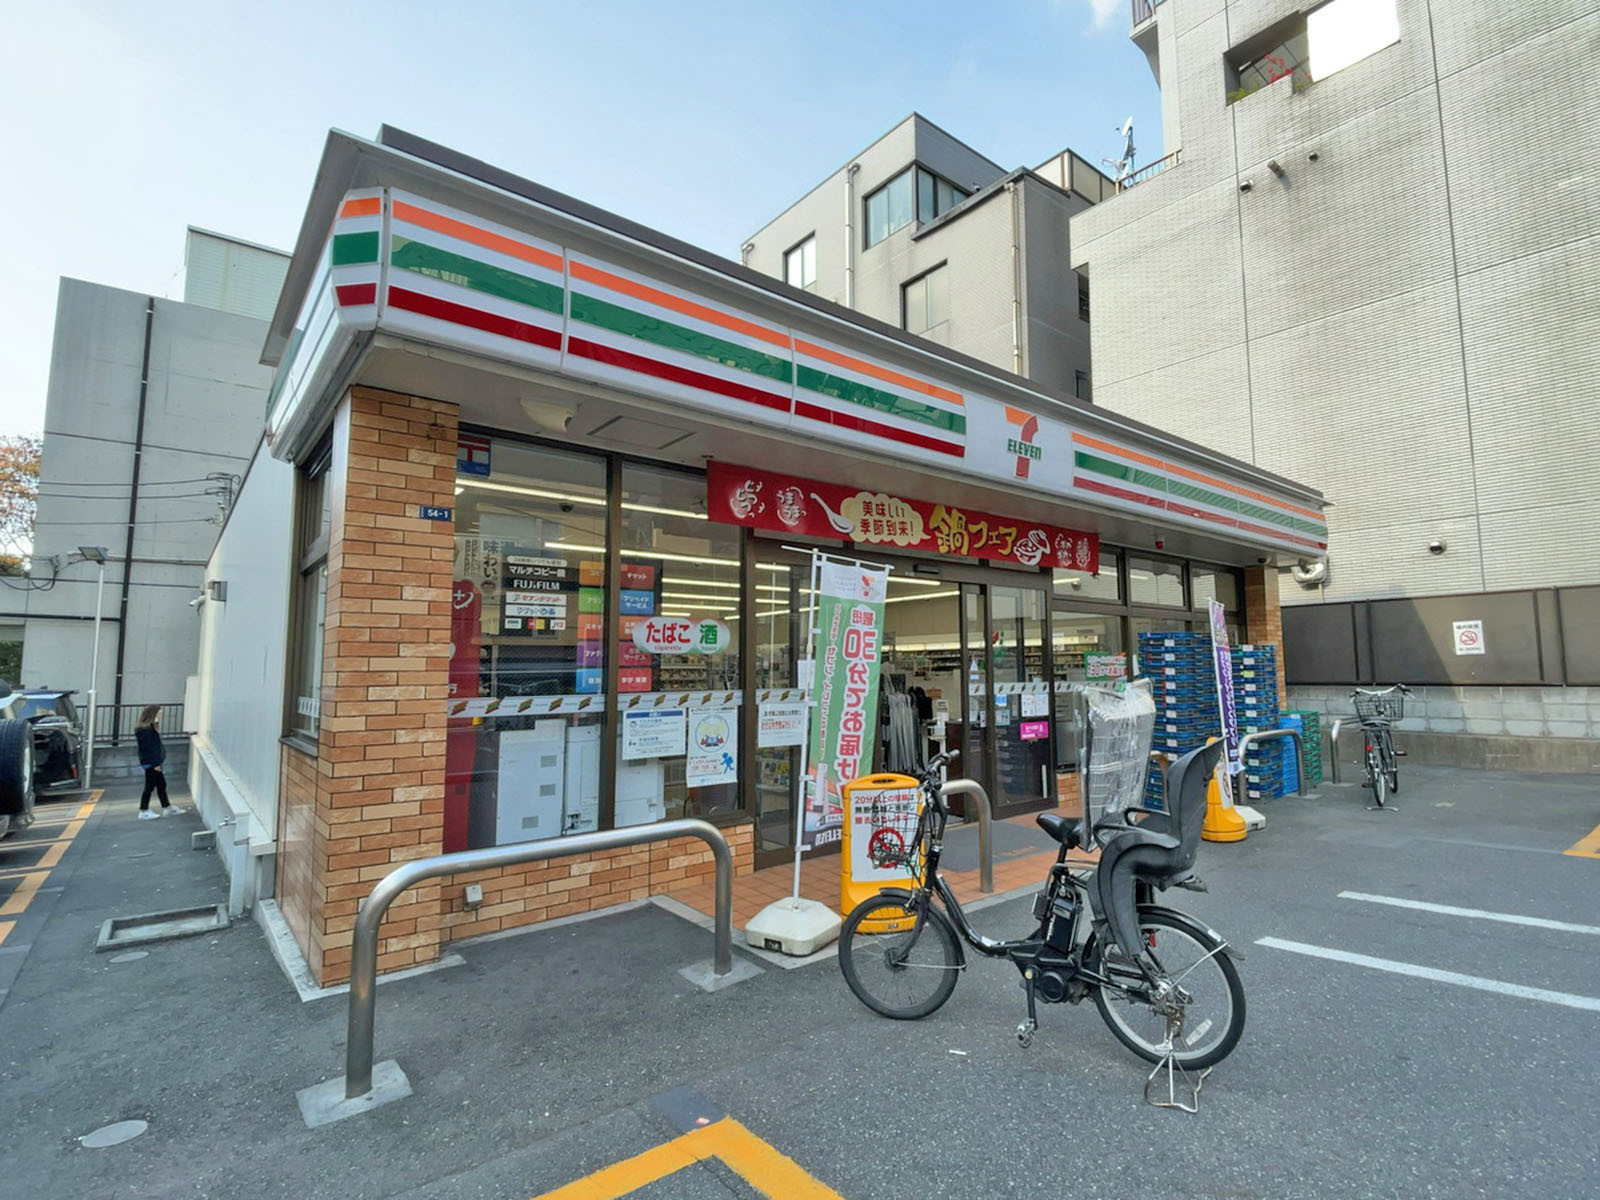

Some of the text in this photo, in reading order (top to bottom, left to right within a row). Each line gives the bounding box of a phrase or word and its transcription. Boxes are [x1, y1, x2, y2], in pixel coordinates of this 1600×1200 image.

[427, 508, 449, 519] 54-1
[861, 500, 906, 519] 美味しい
[929, 503, 1018, 556] 鍋フェア
[646, 622, 691, 644] たばこ
[699, 624, 718, 645] 酒
